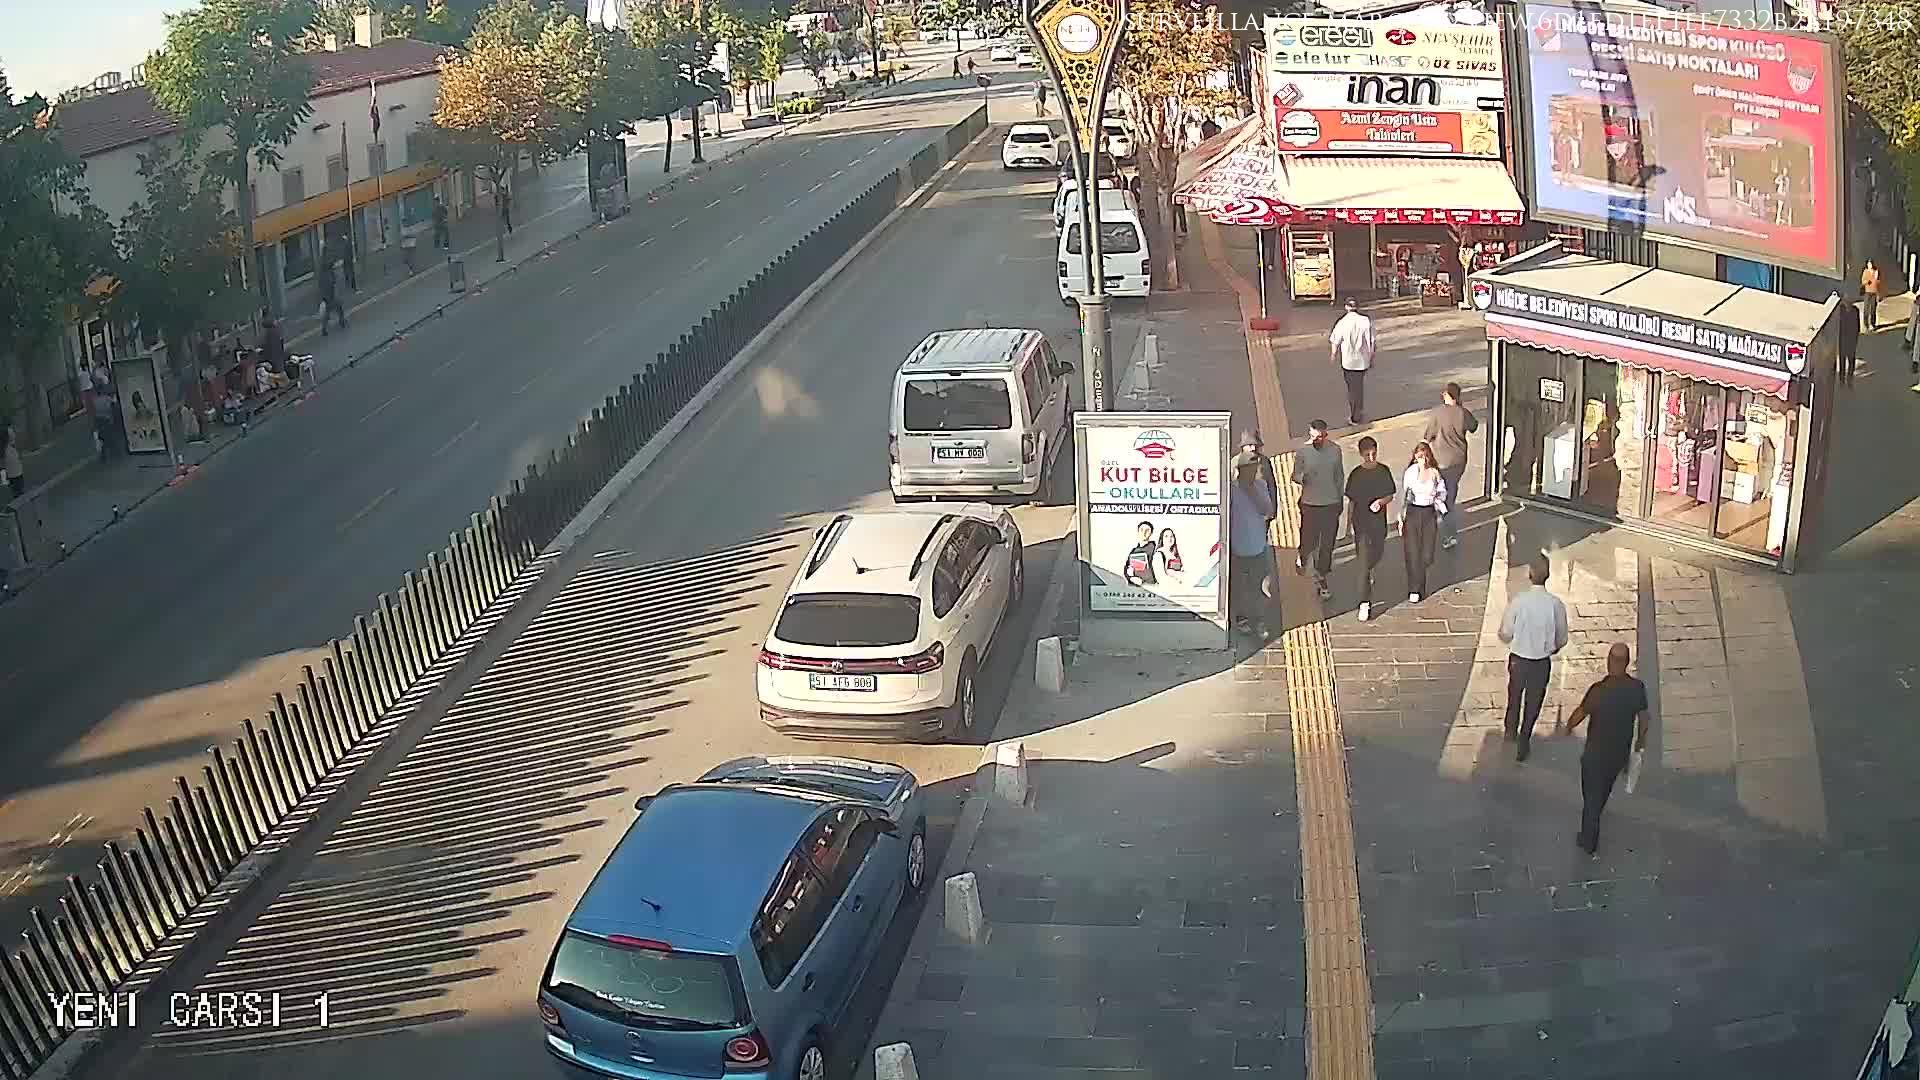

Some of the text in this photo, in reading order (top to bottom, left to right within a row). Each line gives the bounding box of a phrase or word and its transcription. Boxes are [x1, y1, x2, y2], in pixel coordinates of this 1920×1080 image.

[1346, 75, 1440, 106] inan
[1529, 295, 1589, 323] BELEDİYESİ
[1589, 305, 1618, 329] SPOR
[1695, 328, 1727, 355] SATIŞ
[1100, 465, 1209, 484] KUT BİLGE
[1109, 487, 1201, 500] OKULLARI
